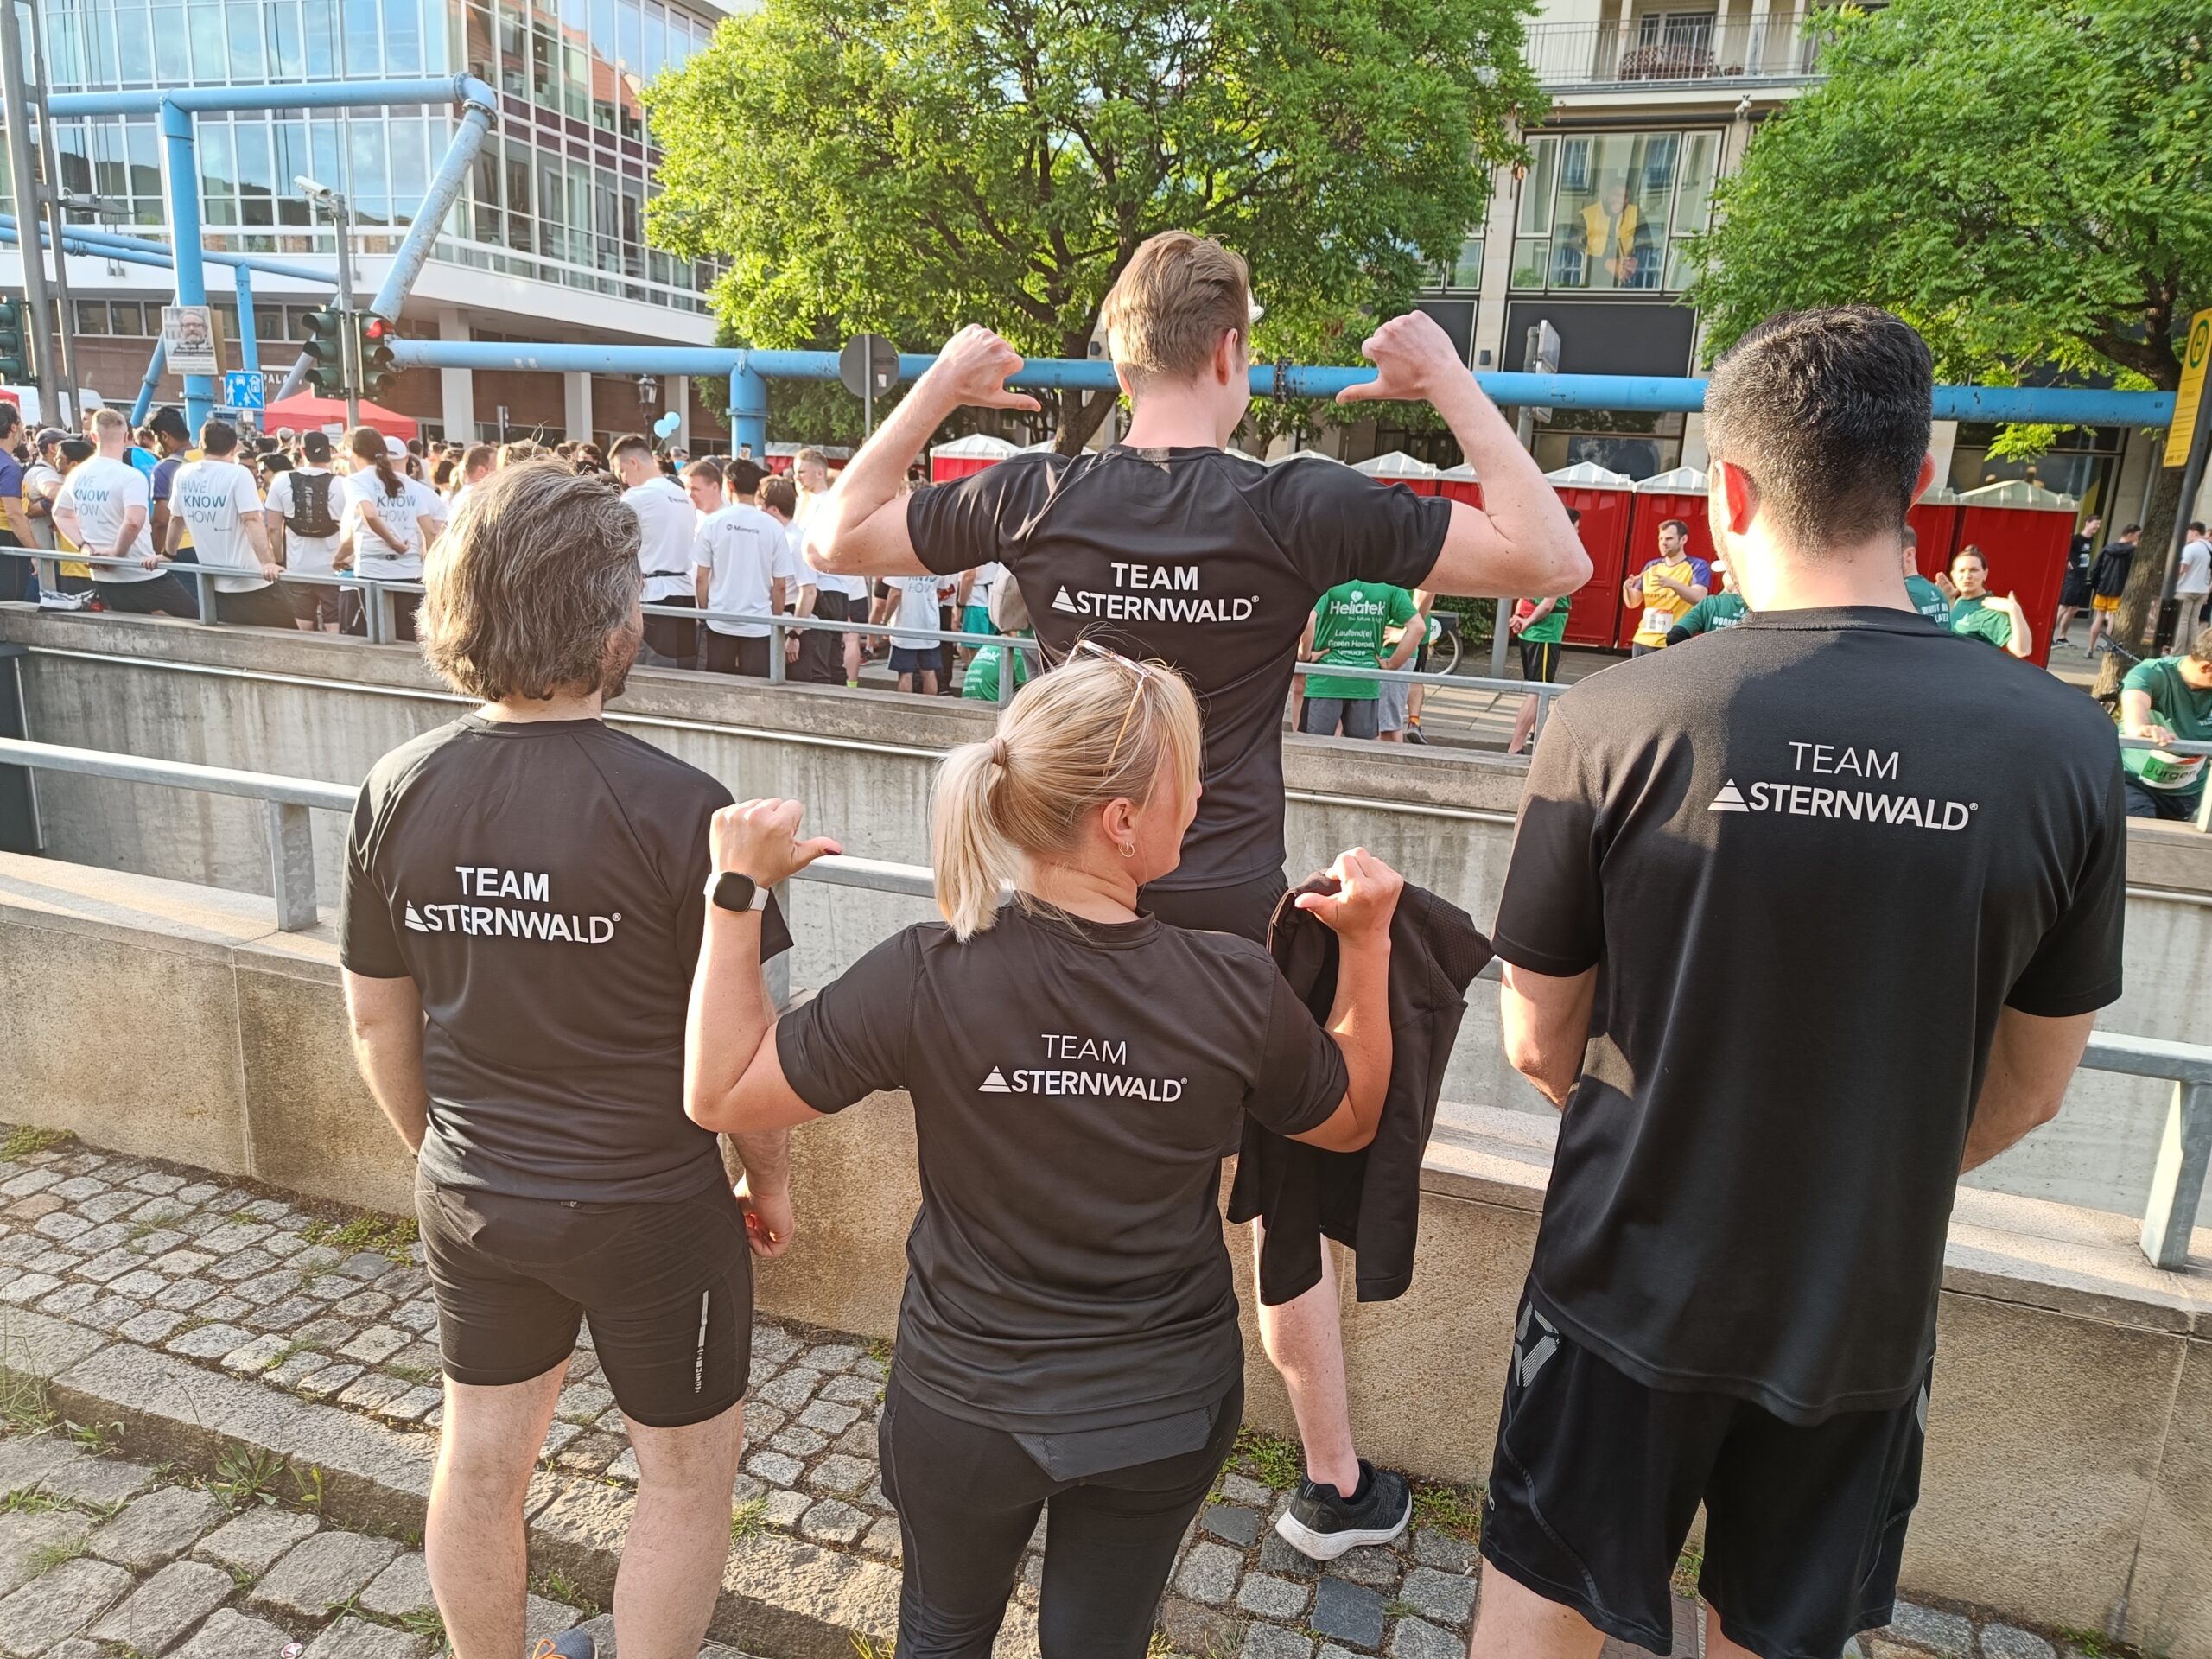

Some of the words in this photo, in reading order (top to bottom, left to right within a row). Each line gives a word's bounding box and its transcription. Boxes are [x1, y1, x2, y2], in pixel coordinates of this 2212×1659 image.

[184, 495, 226, 508] KNOW
[377, 495, 416, 508] KNOW
[187, 510, 217, 524] HOW
[1110, 561, 1198, 591] TEAM
[1330, 599, 1386, 616] Heliatek
[1334, 629, 1373, 639] Laufend(e)
[1789, 741, 1900, 780] TEAM
[455, 866, 550, 903] TEAM
[1041, 1033, 1127, 1065] TEAM
